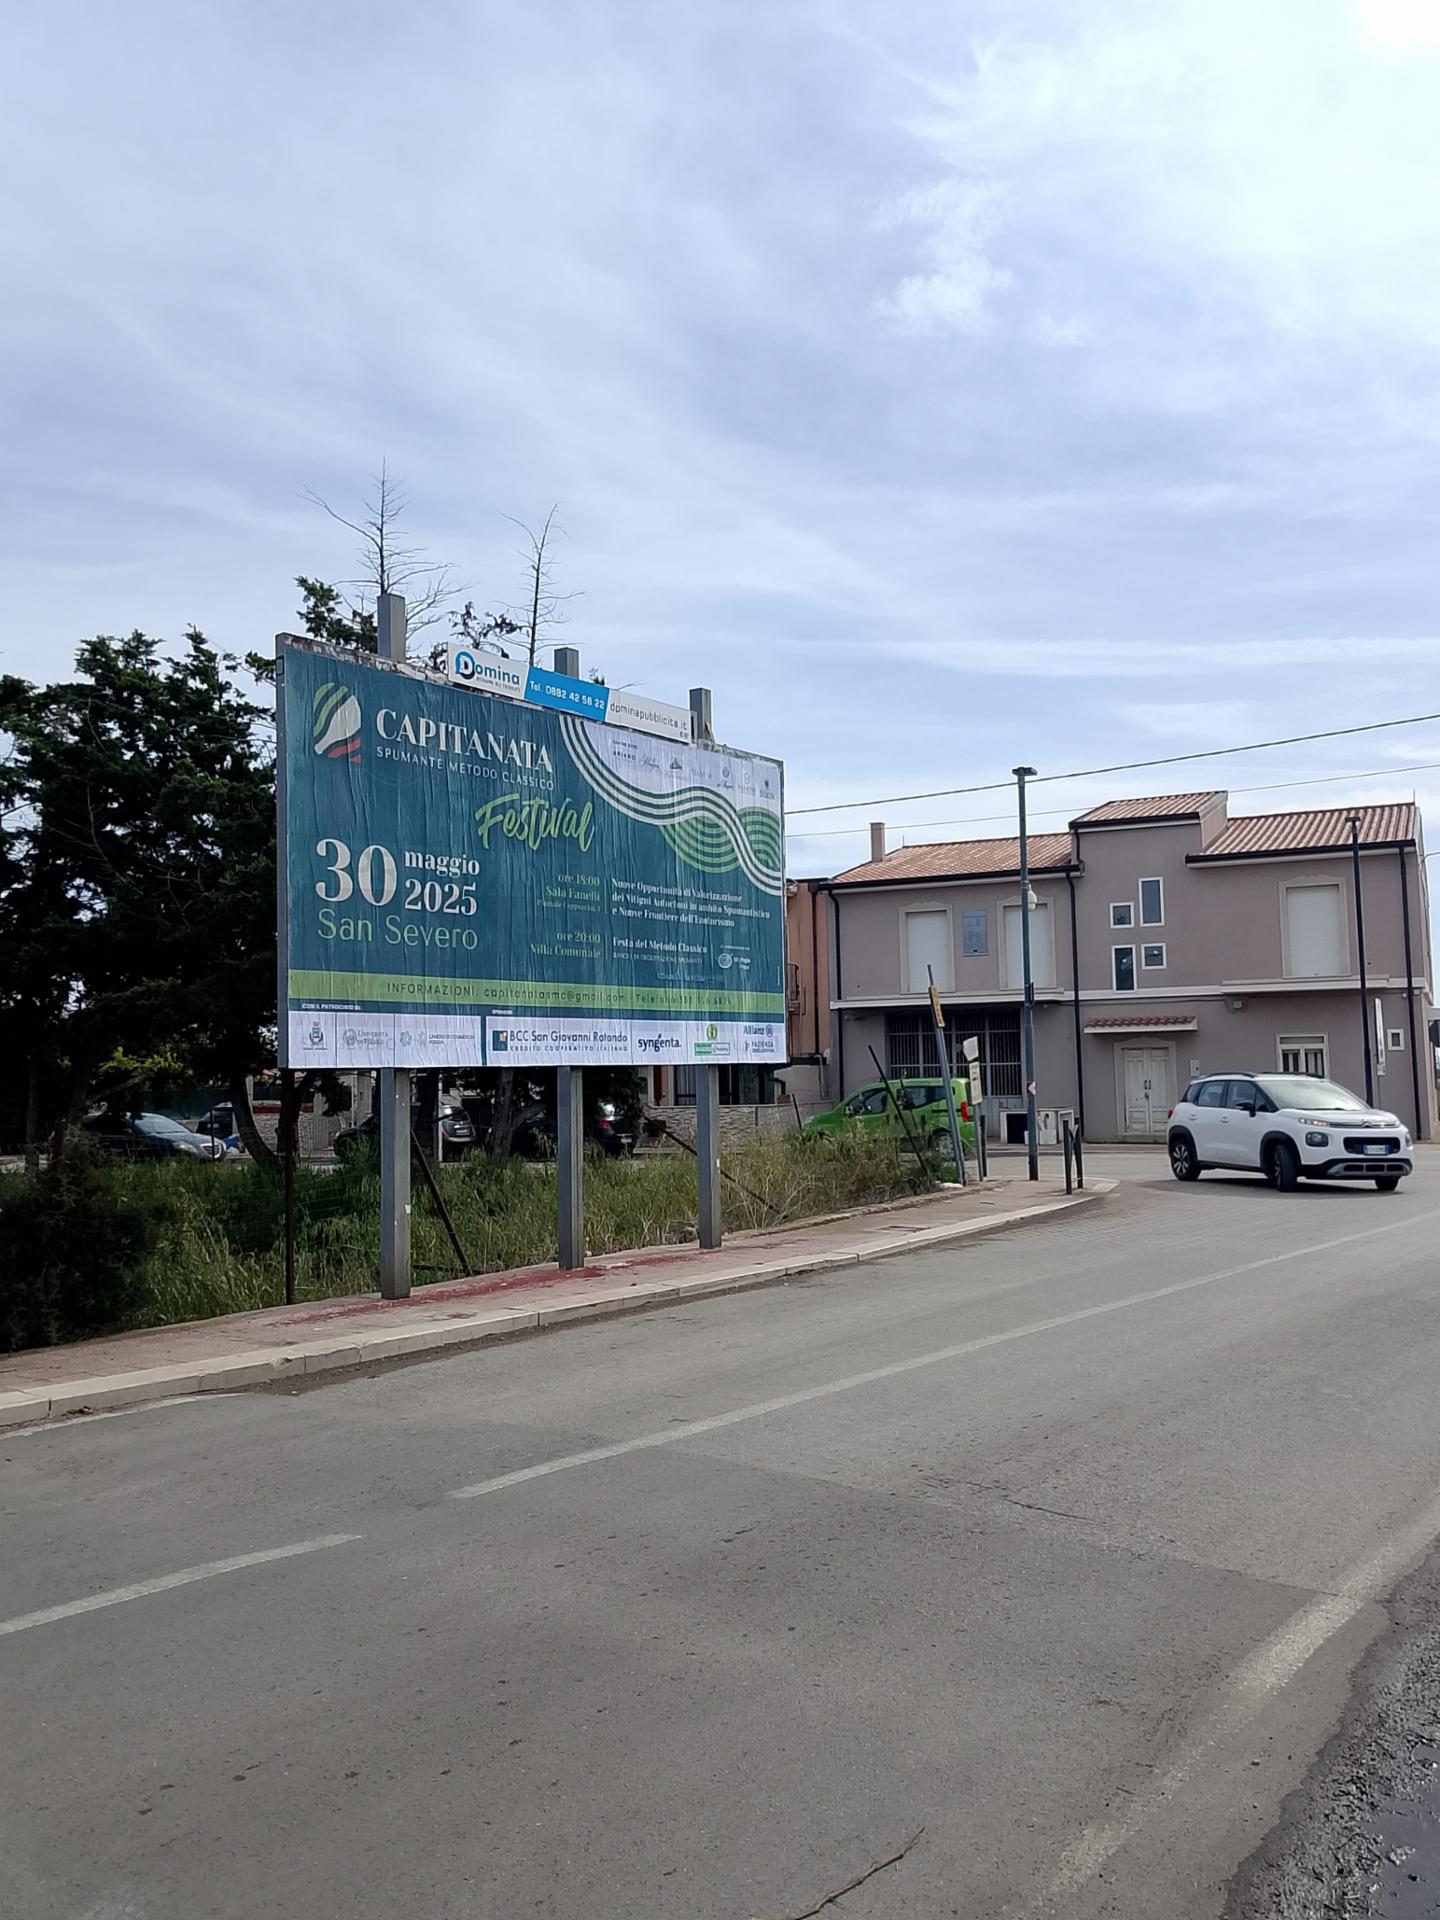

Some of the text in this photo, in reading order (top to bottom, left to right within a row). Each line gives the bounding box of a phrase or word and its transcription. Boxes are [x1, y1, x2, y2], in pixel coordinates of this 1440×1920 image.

[455, 650, 520, 686] Domina
[569, 690, 580, 703] 42
[595, 698, 605, 710] 22
[376, 708, 553, 773] CAPITANATA
[377, 746, 554, 791] SPUMANTE METODO CLASSICO
[475, 793, 594, 852] Festival
[315, 838, 397, 906] 30
[404, 850, 480, 878] maggio
[558, 874, 600, 887] ore 18:00
[611, 877, 636, 890] Nuove
[683, 887, 691, 896] di
[404, 878, 478, 916] 2025
[546, 886, 600, 902] Sala Fanelli
[612, 891, 625, 902] dei
[612, 907, 617, 915] e
[619, 906, 643, 918] Nuove
[644, 909, 679, 922] Frontiere
[318, 908, 478, 950] San Severo
[557, 931, 600, 944] ore 20:00
[530, 943, 601, 959] Villa Comunale
[613, 936, 634, 948] Festa
[635, 938, 648, 949] del
[649, 940, 677, 952] Metodo
[678, 942, 707, 953] Classico
[510, 1031, 627, 1044] BCC San Giovanni Rotondo
[744, 1025, 765, 1035] Allianz
